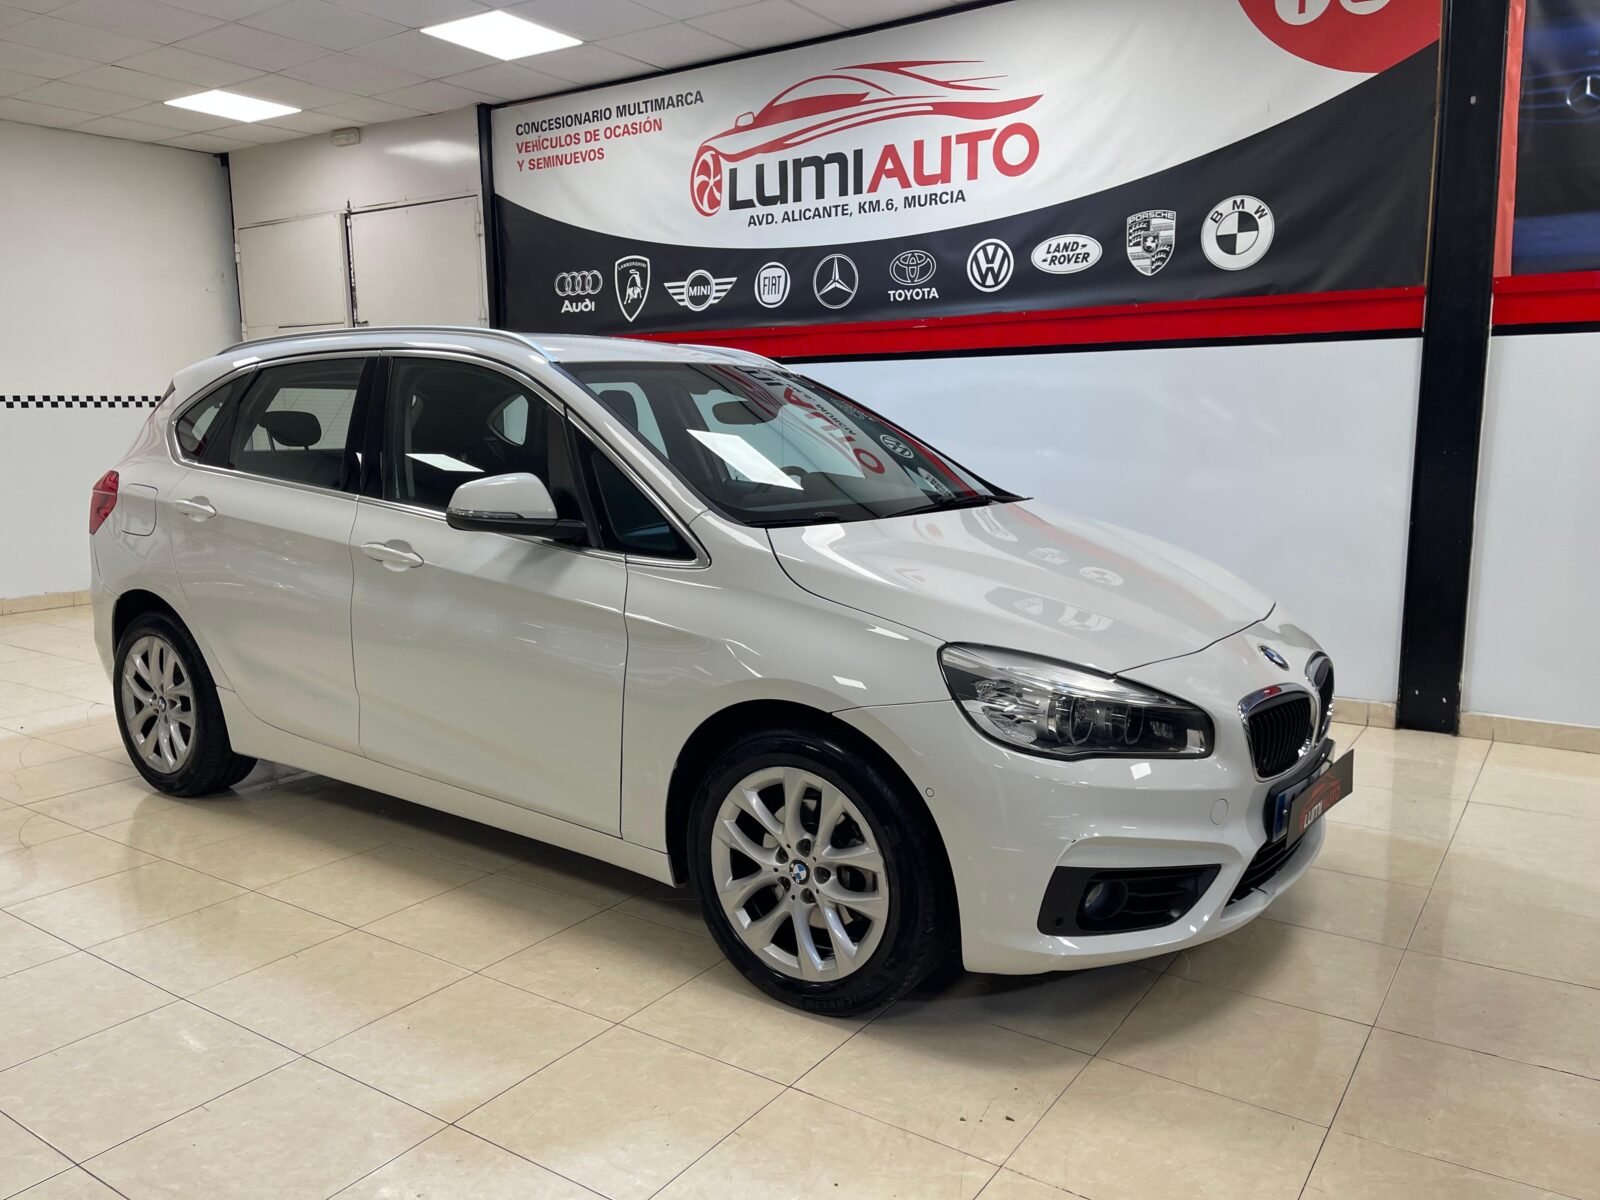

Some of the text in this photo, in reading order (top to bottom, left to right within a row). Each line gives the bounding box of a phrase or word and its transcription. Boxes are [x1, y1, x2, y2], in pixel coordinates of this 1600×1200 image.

[515, 90, 704, 136] CONCESIONARIO MULTIMARCA
[516, 117, 663, 154] VEHÍCULOS DE OCASIÓN
[517, 148, 605, 172] Y SEMINUEVOS
[747, 189, 966, 228] AVD. ALICANTE, KM.6, MURCIA
[1129, 211, 1174, 223] PORSCHE
[1210, 198, 1268, 224] BMW
[688, 285, 711, 297] MINI
[763, 275, 782, 296] FIAT
[888, 287, 939, 302] TOYOTA
[561, 299, 595, 313] Audi
